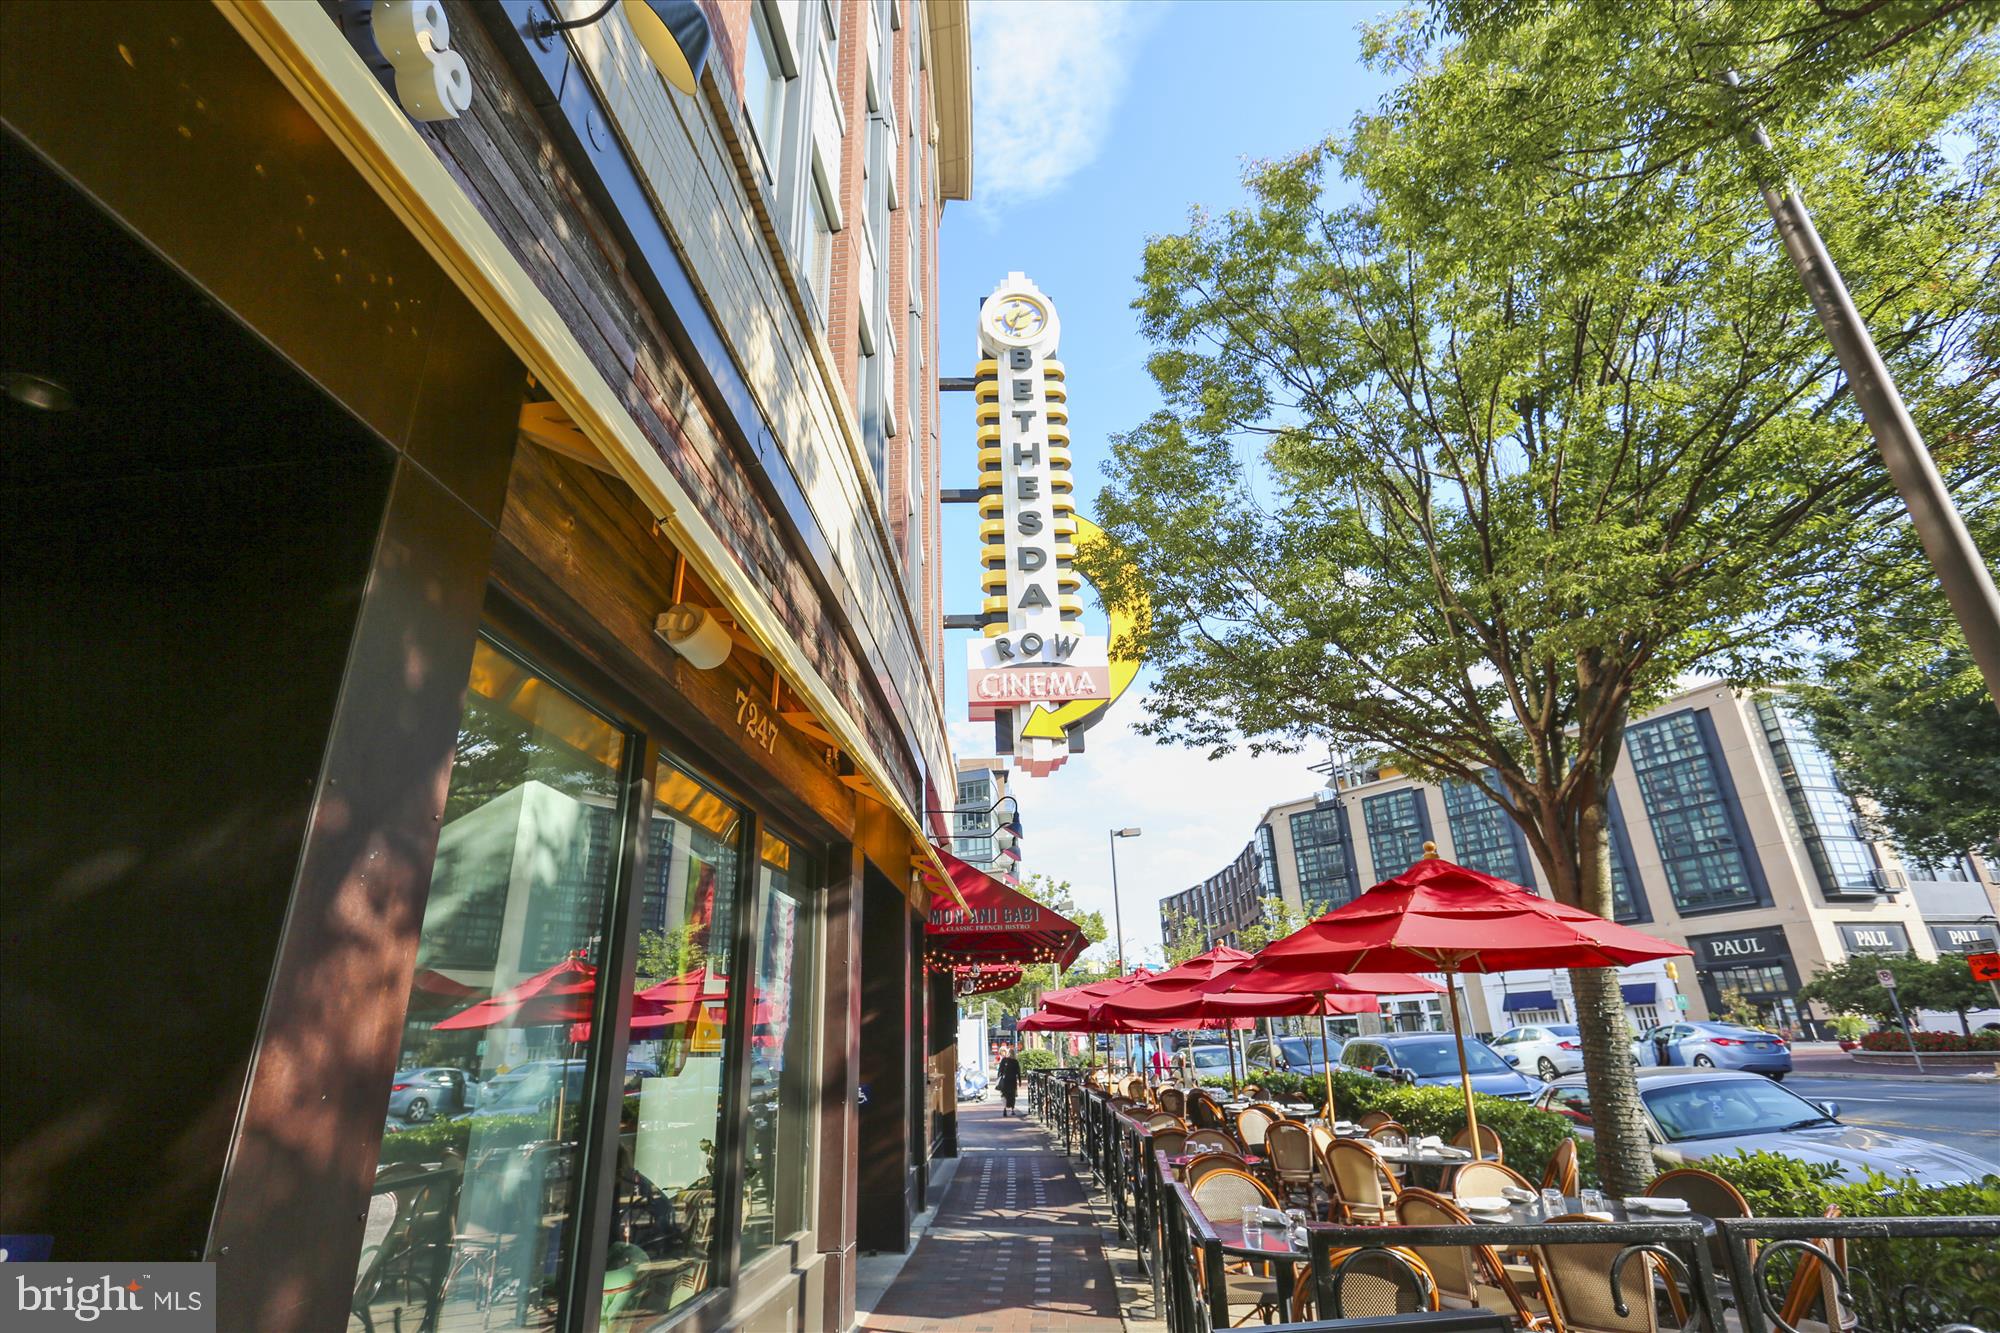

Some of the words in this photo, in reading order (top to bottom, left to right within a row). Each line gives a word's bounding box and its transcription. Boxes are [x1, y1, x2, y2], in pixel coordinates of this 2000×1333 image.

[1010, 348, 1052, 609] BETHESDA
[995, 632, 1080, 661] ROW
[978, 671, 1097, 699] CINEMA
[735, 687, 779, 754] 7247
[928, 908, 964, 925] MON
[1003, 906, 1040, 923] GABI
[1711, 937, 1765, 956] PAUL
[1853, 930, 1893, 946] PAUL
